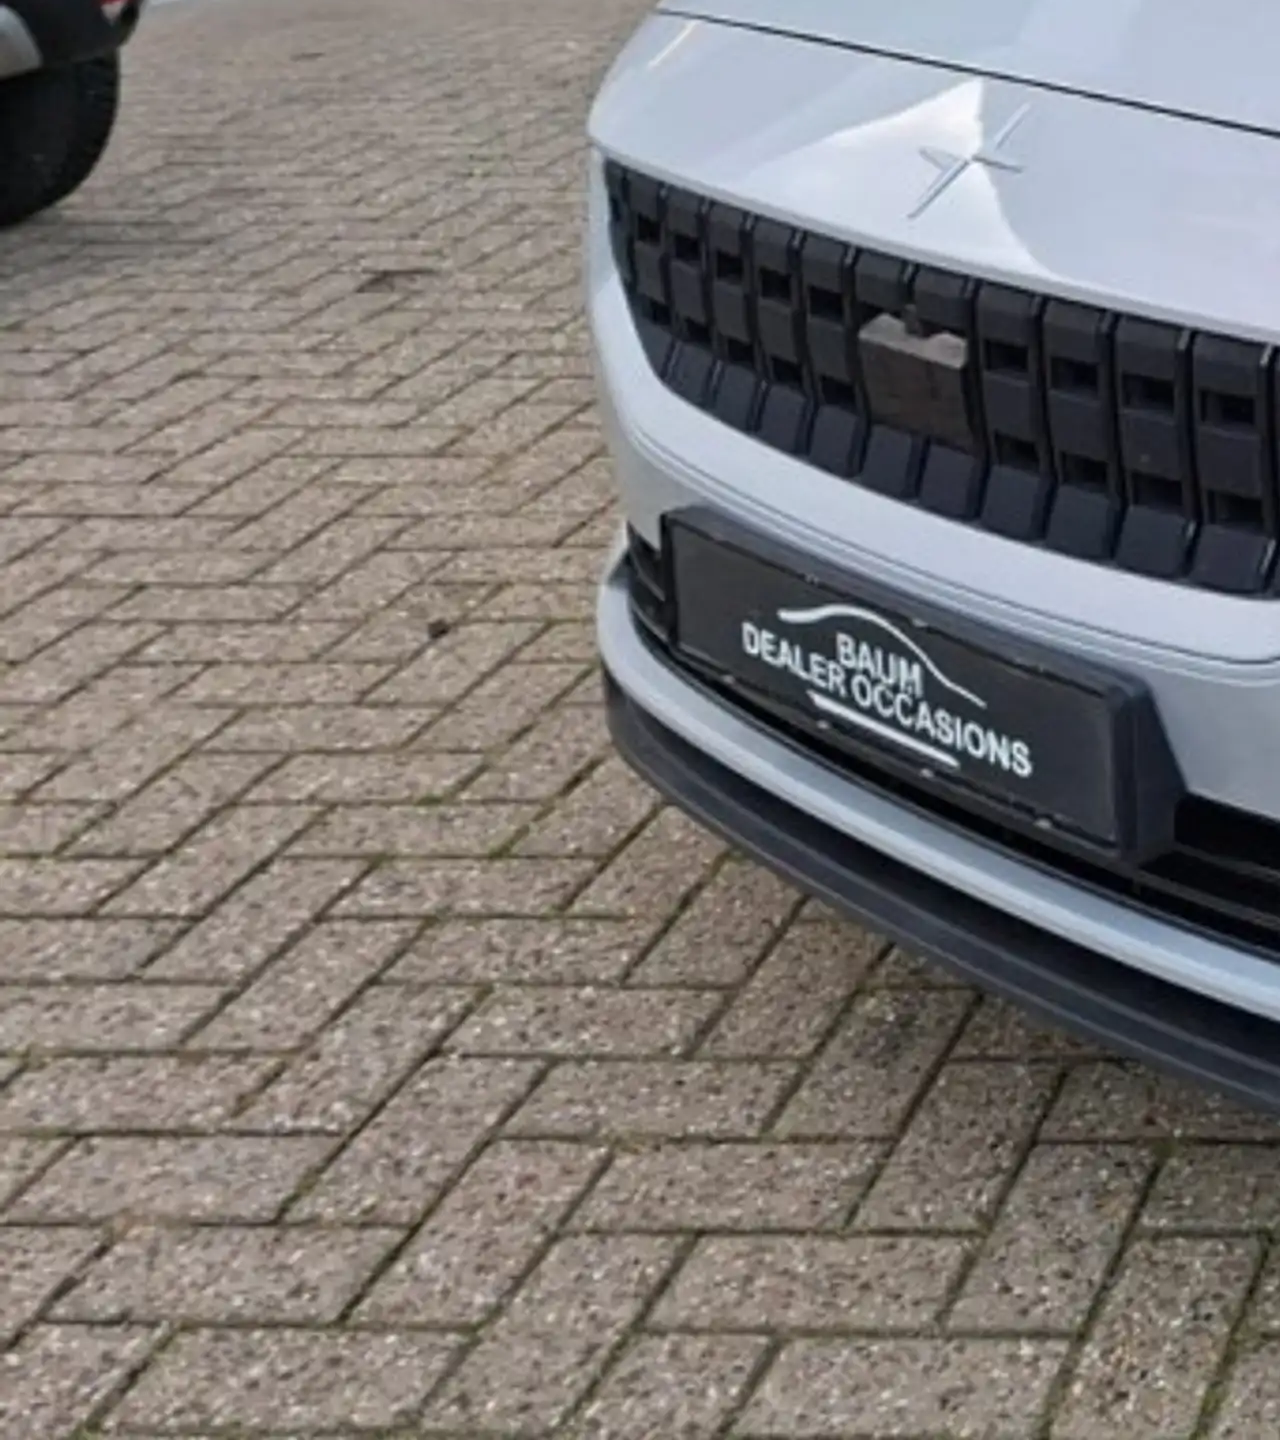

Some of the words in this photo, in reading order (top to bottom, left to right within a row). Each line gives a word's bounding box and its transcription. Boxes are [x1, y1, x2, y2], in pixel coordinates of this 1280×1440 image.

[742, 621, 847, 696] DEALER
[851, 675, 1033, 778] OCCASIONS
[836, 632, 923, 698] BAUM
